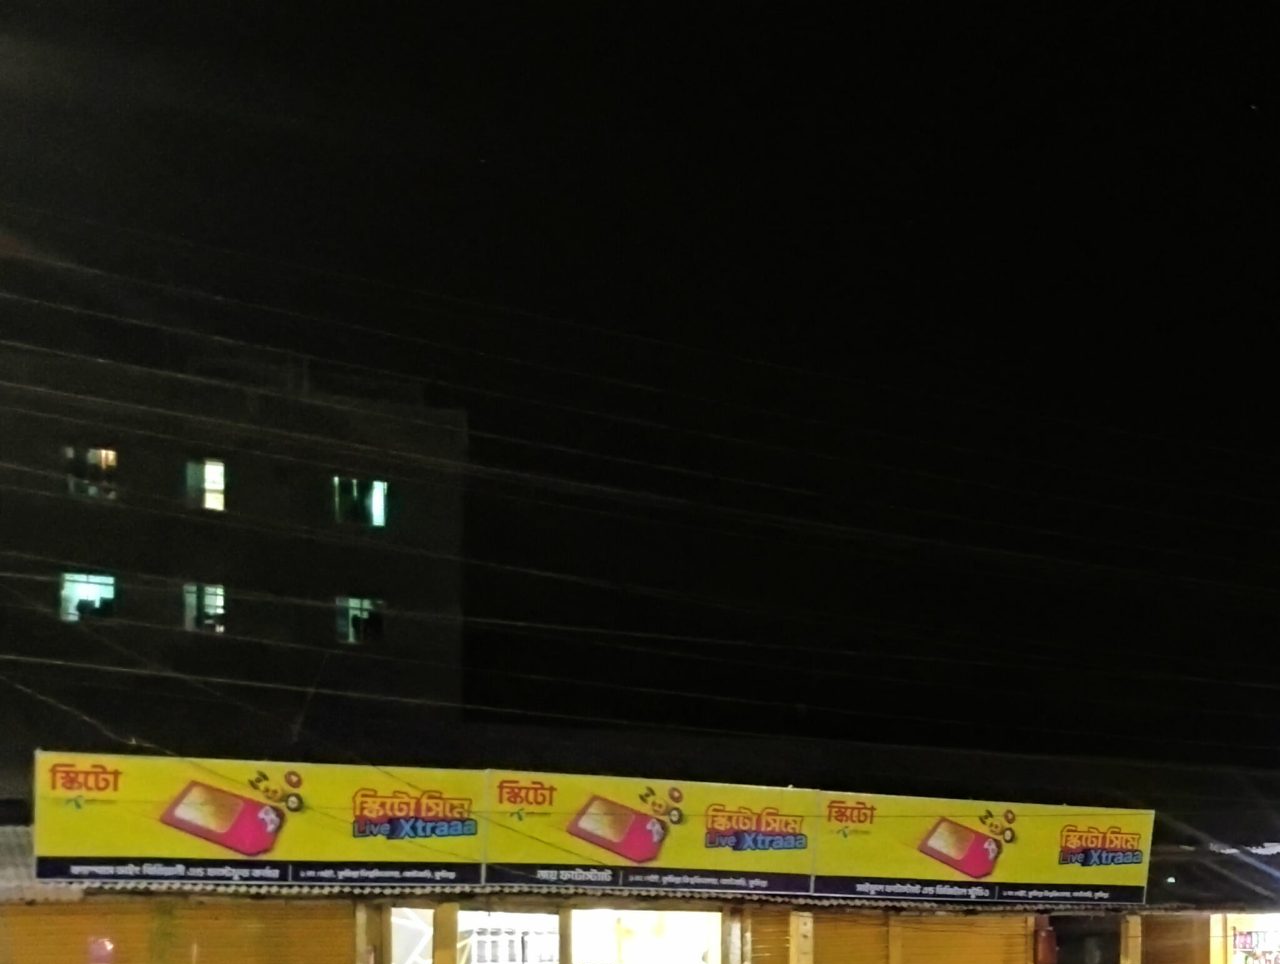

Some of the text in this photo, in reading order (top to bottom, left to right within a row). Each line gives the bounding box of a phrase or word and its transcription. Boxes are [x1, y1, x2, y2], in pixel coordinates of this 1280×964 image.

[49, 763, 122, 792] স্কিটো
[353, 788, 418, 819] স্কিটো
[498, 780, 557, 806] স্কিটো
[706, 804, 757, 830] স্কিটো
[827, 800, 877, 824] স্কিটো
[353, 818, 477, 838] Live Xtraaa
[1061, 824, 1105, 848] স্কিটো
[705, 831, 808, 850] Live Xtraaa
[1058, 849, 1143, 866] Live Xtraaa
